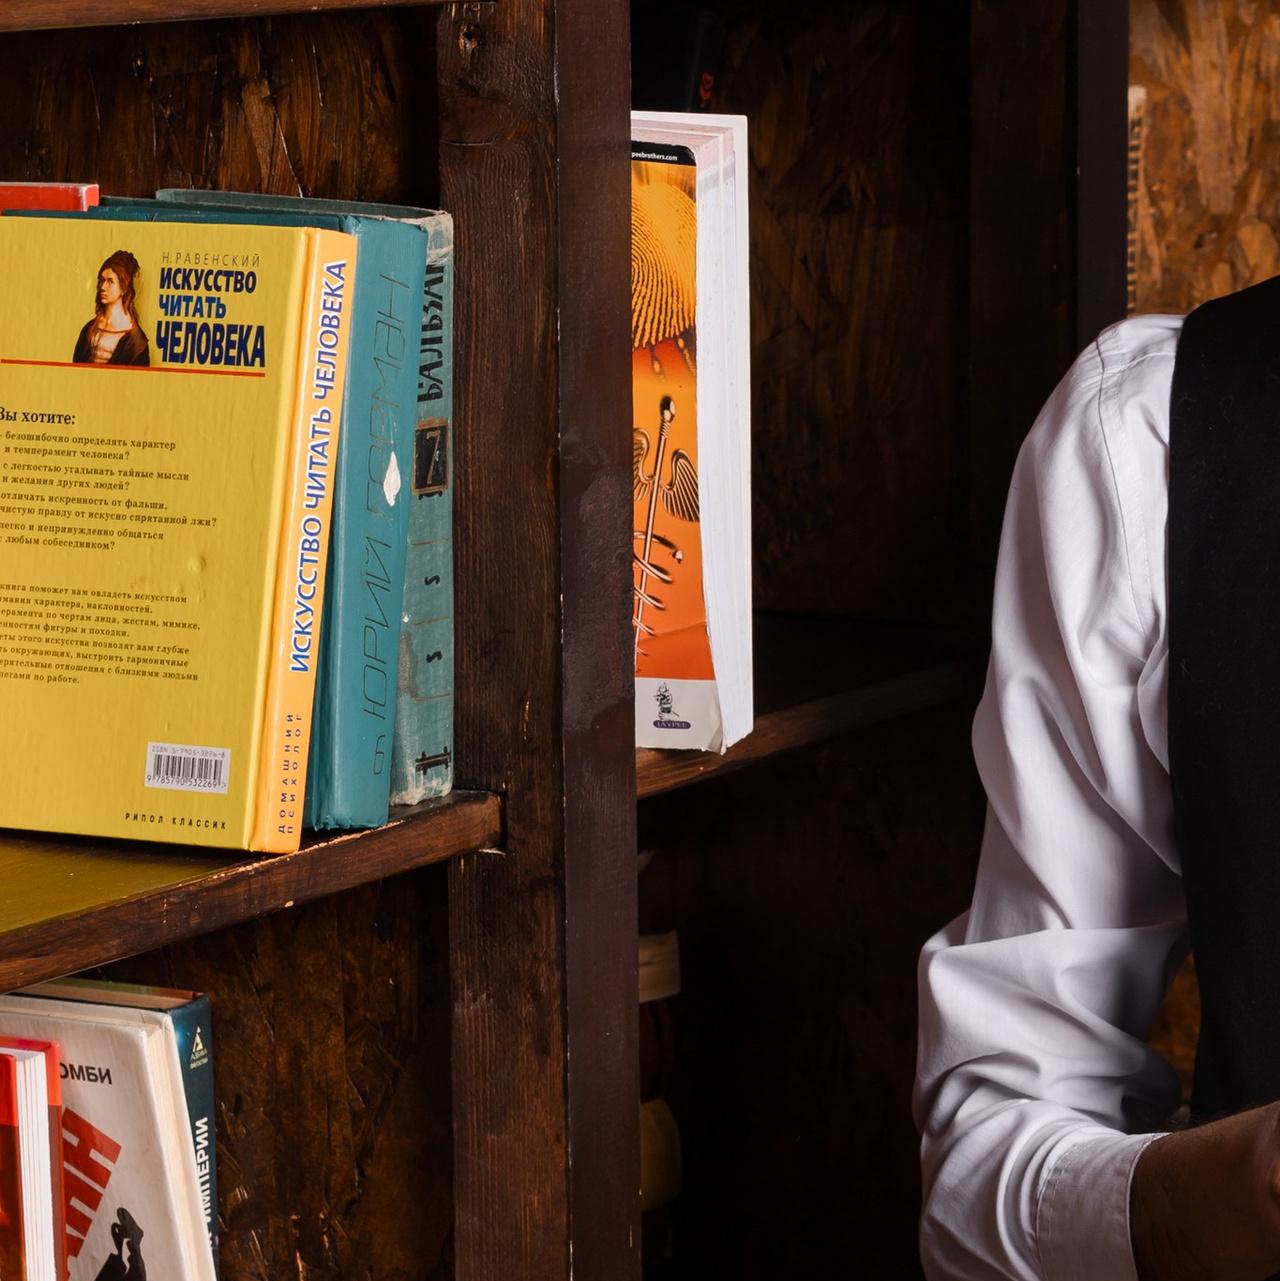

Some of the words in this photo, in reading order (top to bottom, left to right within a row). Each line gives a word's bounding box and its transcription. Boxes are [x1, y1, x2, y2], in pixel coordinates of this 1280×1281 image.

[160, 267, 257, 294] ИСКУССТВО
[159, 294, 226, 319] ЧИТАТЬ
[314, 261, 347, 400] ЧЕЛОВЕКА
[156, 320, 266, 368] ЧЕЛОВЕКА
[22, 411, 75, 426] хотите:
[5, 429, 69, 445] безошибочно
[72, 436, 127, 449] определять
[130, 439, 176, 452] характер
[13, 446, 77, 458] темперамент
[80, 451, 130, 461] человека?
[305, 406, 331, 509] ЧИТАТЬ
[426, 430, 441, 485] 7
[11, 462, 61, 473] легкостью
[64, 466, 114, 477] угадывать
[118, 468, 154, 479] тайные
[157, 472, 189, 481] мысли
[2, 475, 8, 483] и
[11, 476, 54, 487] желания
[57, 479, 90, 489] других
[93, 481, 130, 491] людей?
[1, 492, 45, 502] отличать
[48, 495, 108, 508] искренность
[125, 499, 168, 510] фальши,
[0, 505, 35, 517] чистую
[38, 508, 72, 519] правду
[88, 511, 127, 522] искусно
[130, 514, 187, 526] спрятанной
[190, 518, 217, 527] лжи?
[38, 525, 114, 538] непринужденно
[117, 529, 164, 541] общаться
[5, 535, 40, 546] любым
[43, 537, 115, 551] собеседником?
[29, 586, 68, 596] поможет
[91, 590, 132, 600] овладеть
[134, 593, 187, 604] искусством
[291, 517, 322, 672] ИСКУССТВО
[34, 598, 84, 611] характера,
[87, 602, 153, 615] наклонностей,
[43, 622, 78, 635] фигуры
[89, 628, 130, 638] походки.
[60, 613, 91, 623] чертам
[123, 617, 159, 628] жестам,
[162, 620, 200, 631] мимике,
[363, 535, 392, 720] ЮРИЙ
[18, 635, 42, 644] этого
[45, 637, 89, 648] искусства
[92, 641, 134, 651] позволят
[157, 645, 189, 656] глубже
[10, 647, 73, 660] окружающих,
[76, 652, 124, 664] выстроить
[127, 655, 188, 668] гармоничные
[47, 675, 80, 684] работе.
[55, 663, 105, 674] отношения
[115, 666, 159, 678] близкими
[162, 671, 199, 681] людьми
[152, 745, 168, 753] ISBN
[287, 715, 302, 834] ПСИХОЛОГ
[125, 812, 164, 824] РИПОЛ
[172, 817, 226, 830] КЛАССИК
